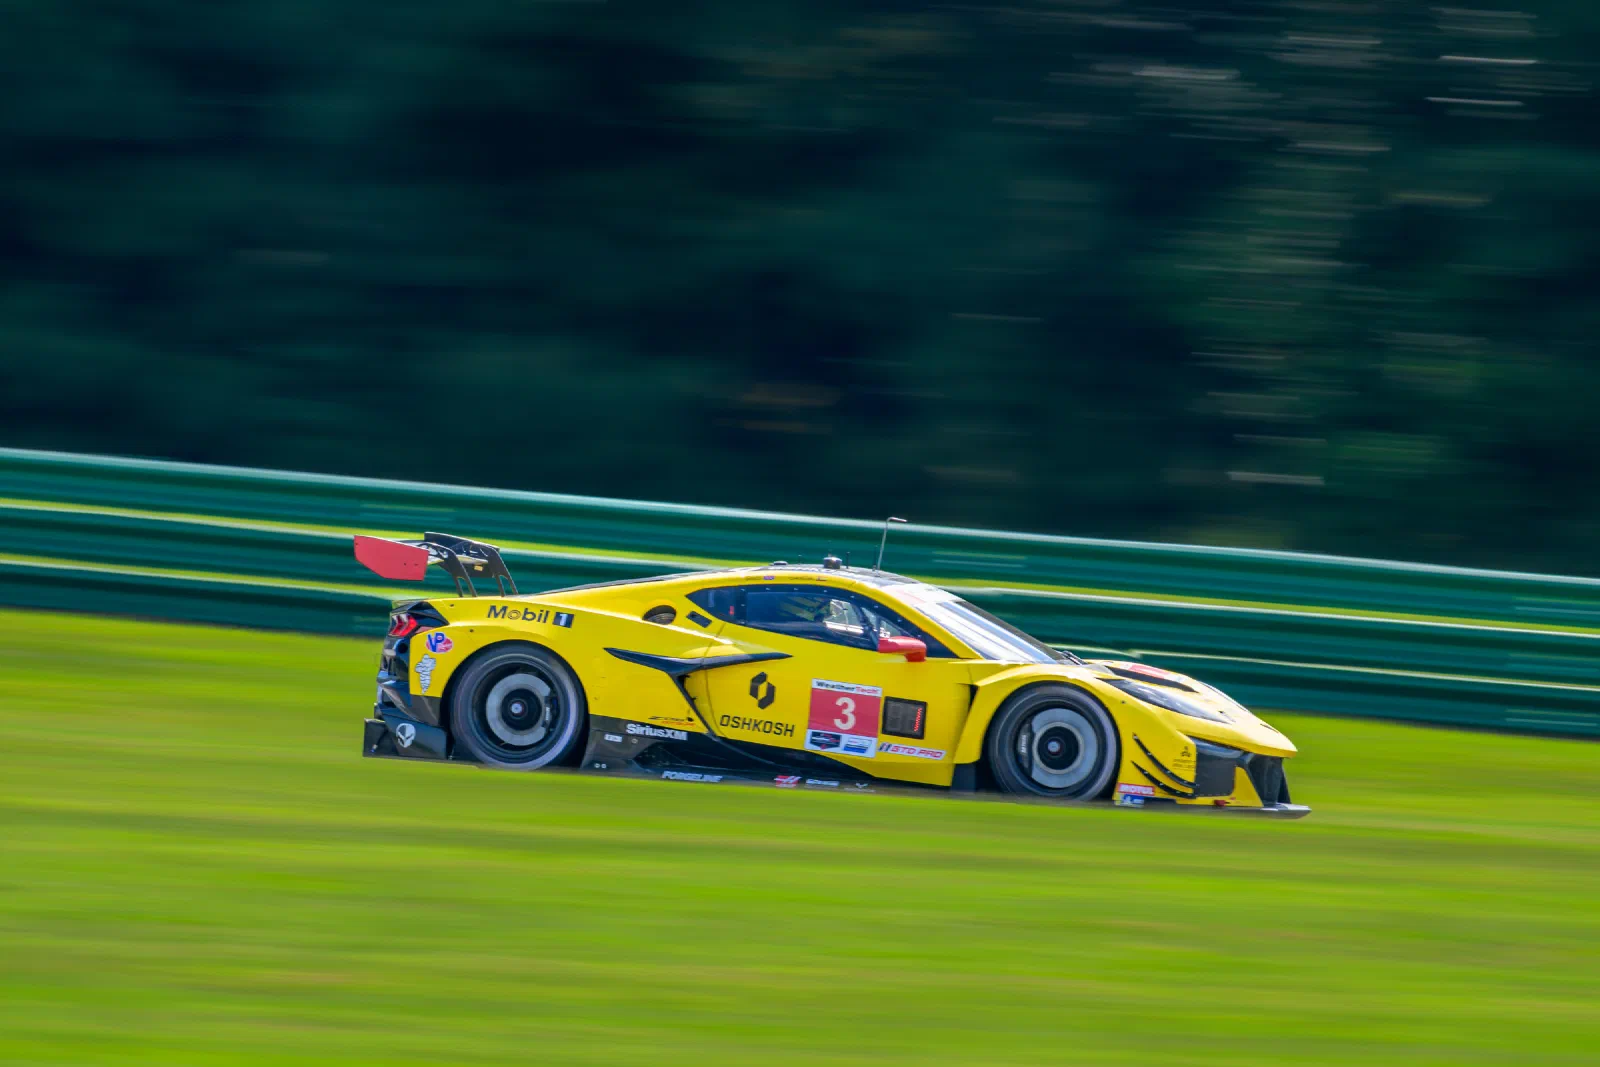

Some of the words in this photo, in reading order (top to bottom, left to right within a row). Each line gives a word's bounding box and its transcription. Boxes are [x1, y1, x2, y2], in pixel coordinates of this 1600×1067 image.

[487, 605, 550, 624] Mobil
[427, 632, 445, 653] VP
[833, 697, 856, 730] 3
[626, 723, 688, 741] SiriusXM
[720, 714, 796, 738] OSHKOSH
